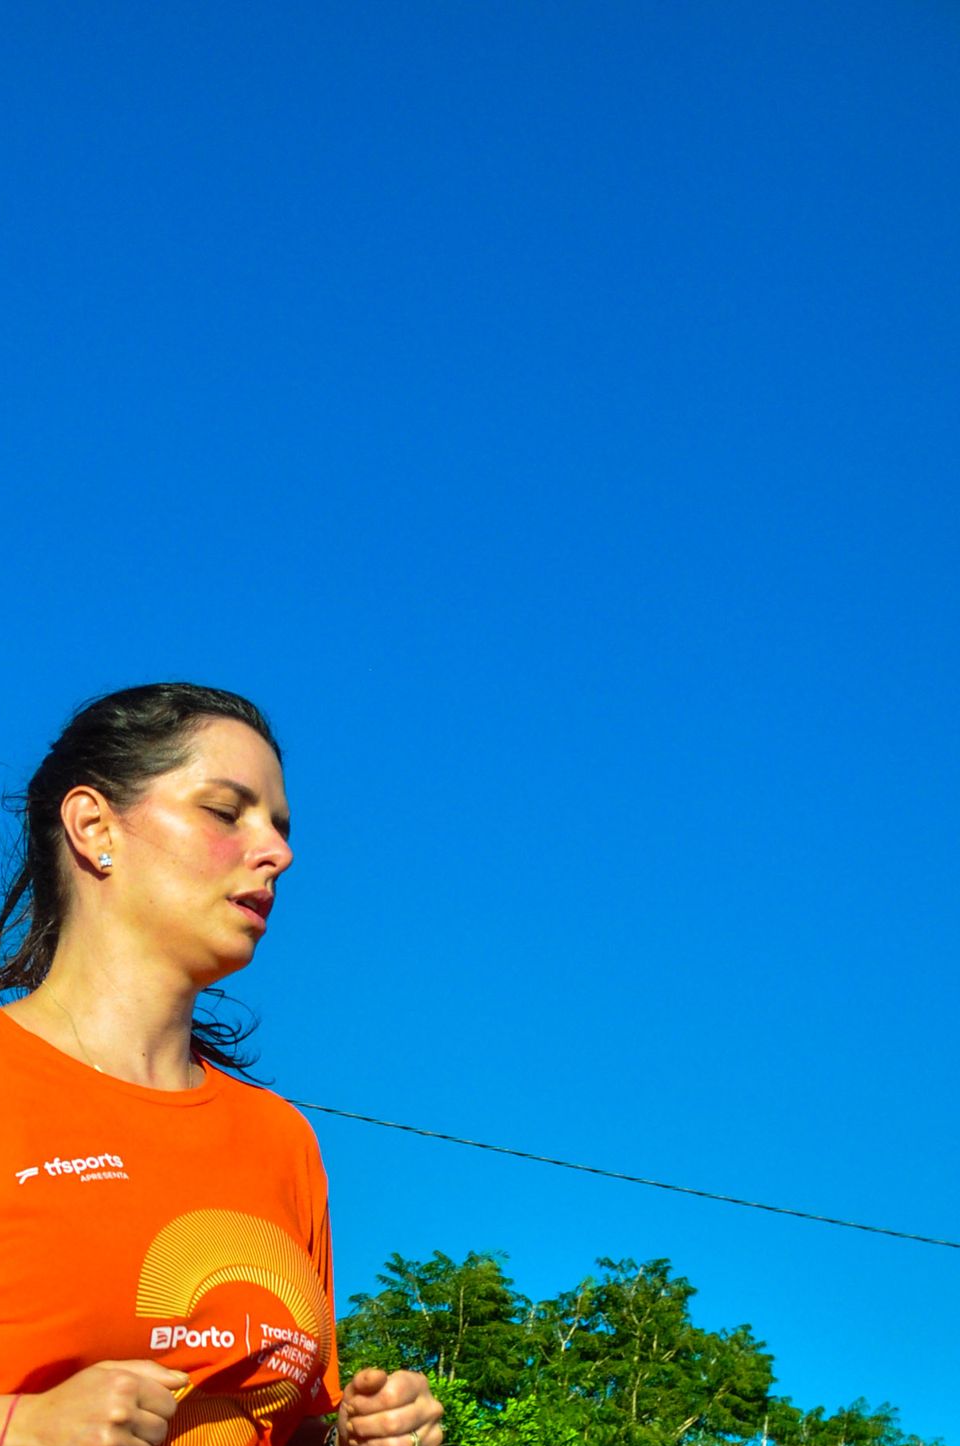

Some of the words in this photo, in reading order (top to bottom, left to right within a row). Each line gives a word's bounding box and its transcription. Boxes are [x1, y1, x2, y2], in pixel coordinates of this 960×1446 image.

[43, 1152, 125, 1176] tfsports
[80, 1171, 129, 1182] APRESENTA
[171, 1325, 235, 1349] Porto
[260, 1338, 315, 1372] ERIENCE
[251, 1352, 309, 1385] UNNING
